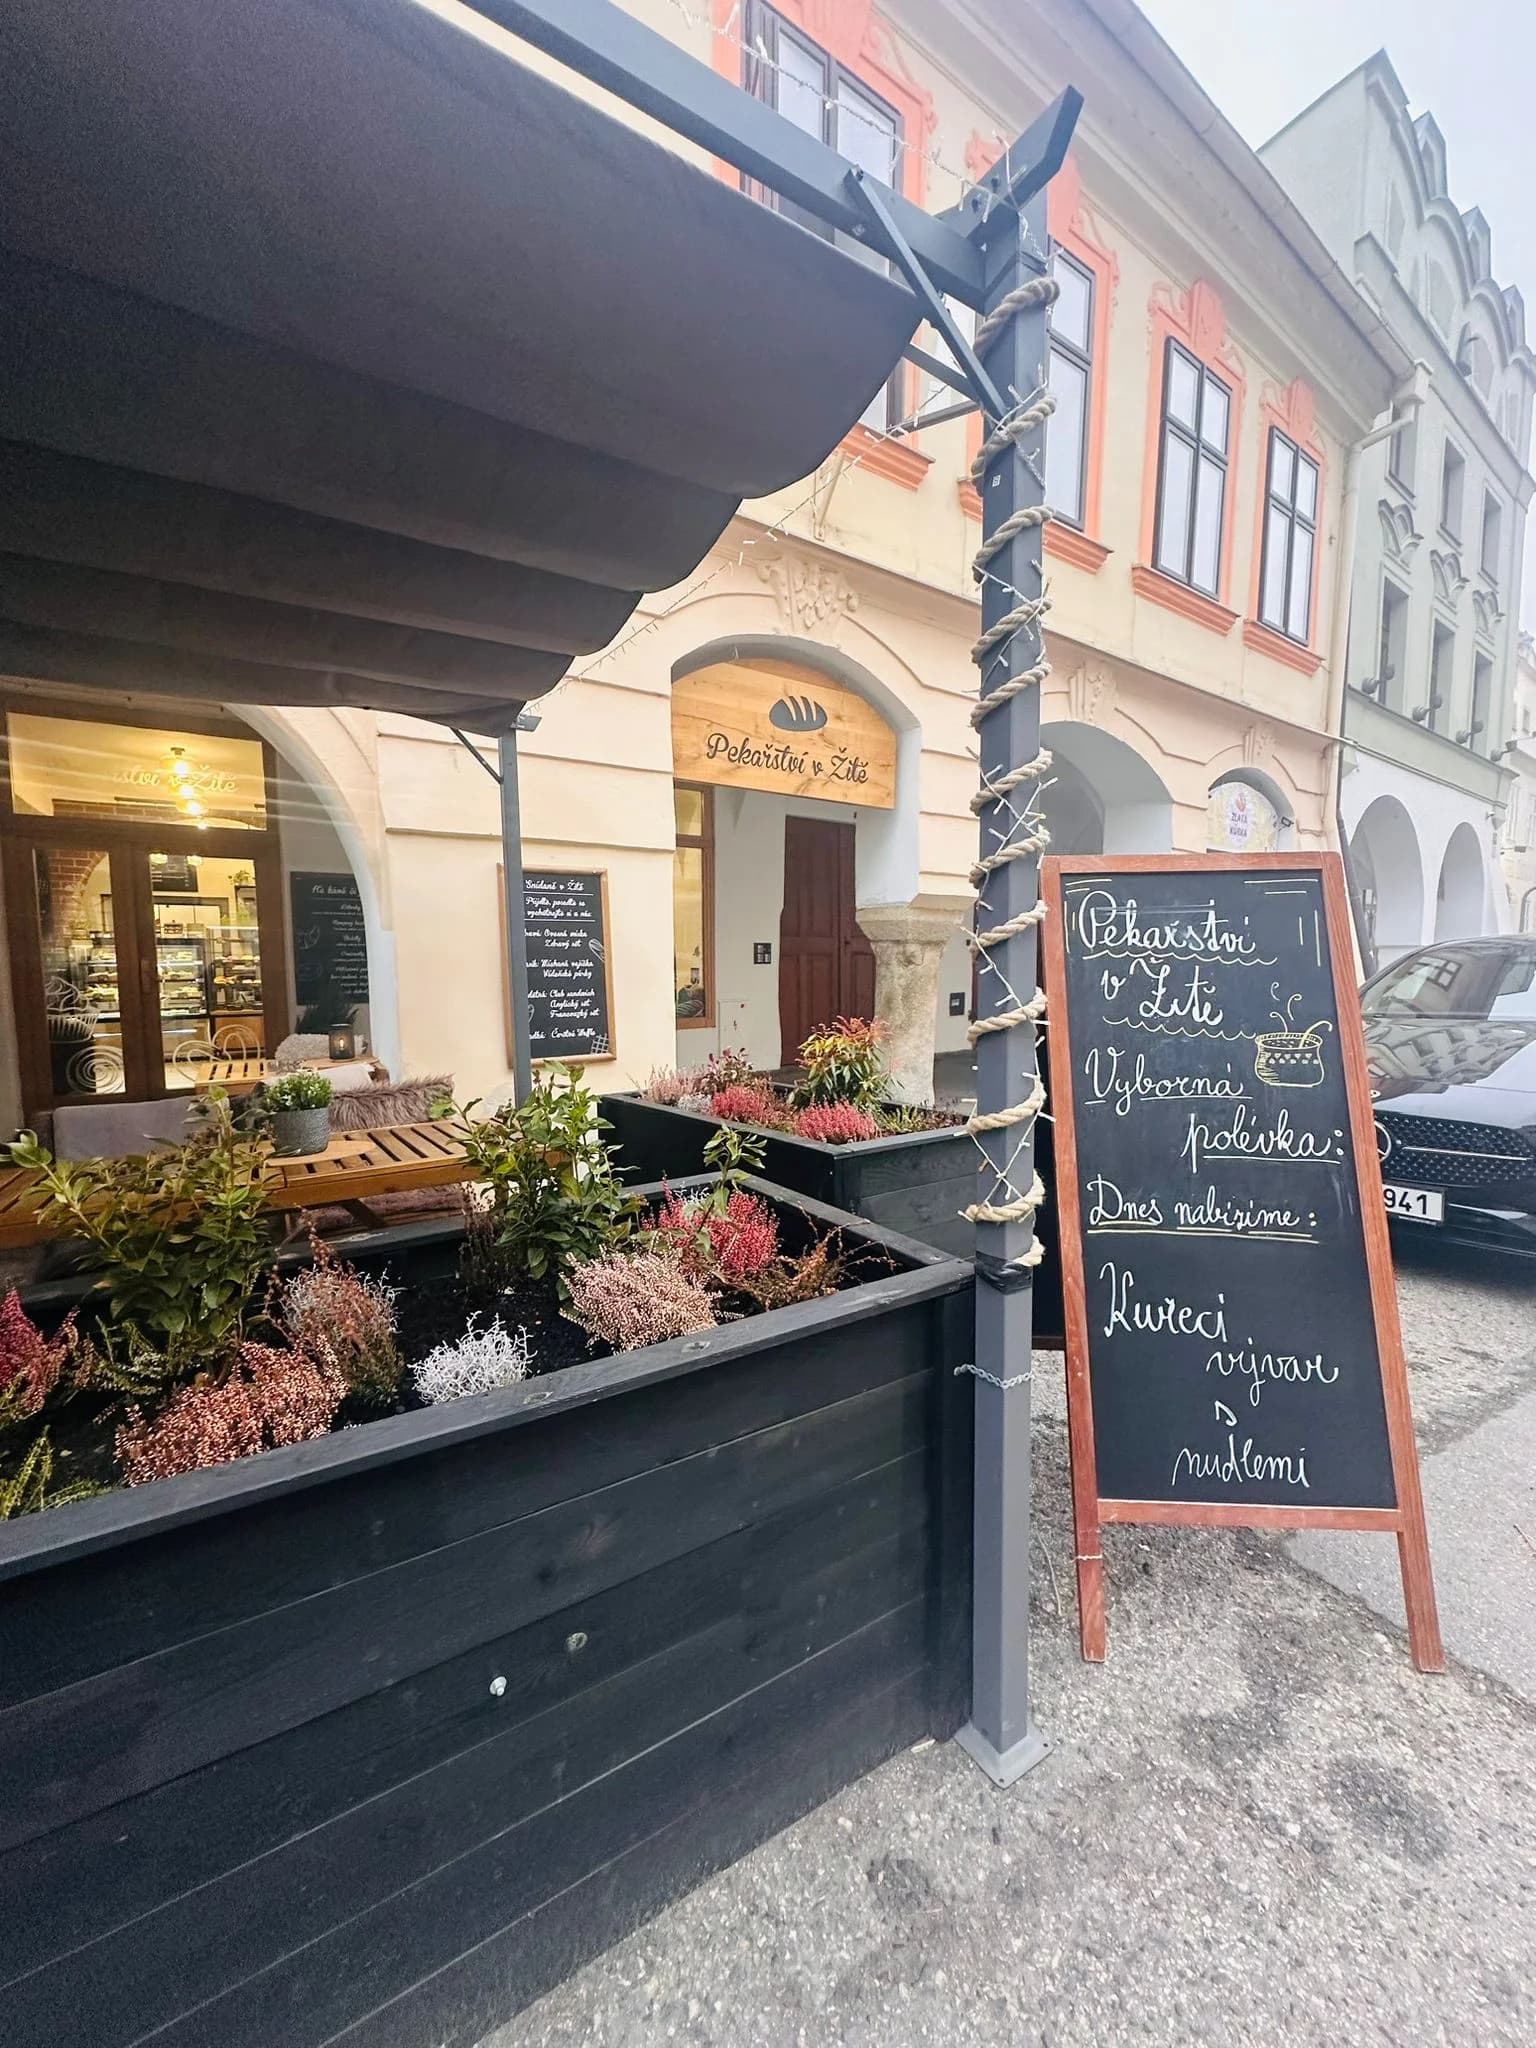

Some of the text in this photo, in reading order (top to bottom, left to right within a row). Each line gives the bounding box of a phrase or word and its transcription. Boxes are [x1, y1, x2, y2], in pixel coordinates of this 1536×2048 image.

[706, 733, 869, 784] Pekařství v Žitě
[1079, 891, 1255, 953] Pekařství
[1101, 957, 1223, 1025] v Žitě
[1181, 1103, 1345, 1174] polévka:
[1086, 1173, 1164, 1226] Dnes
[1384, 1188, 1427, 1215] 941
[1215, 1400, 1238, 1427] s
[1172, 1433, 1311, 1488] nudlemi
